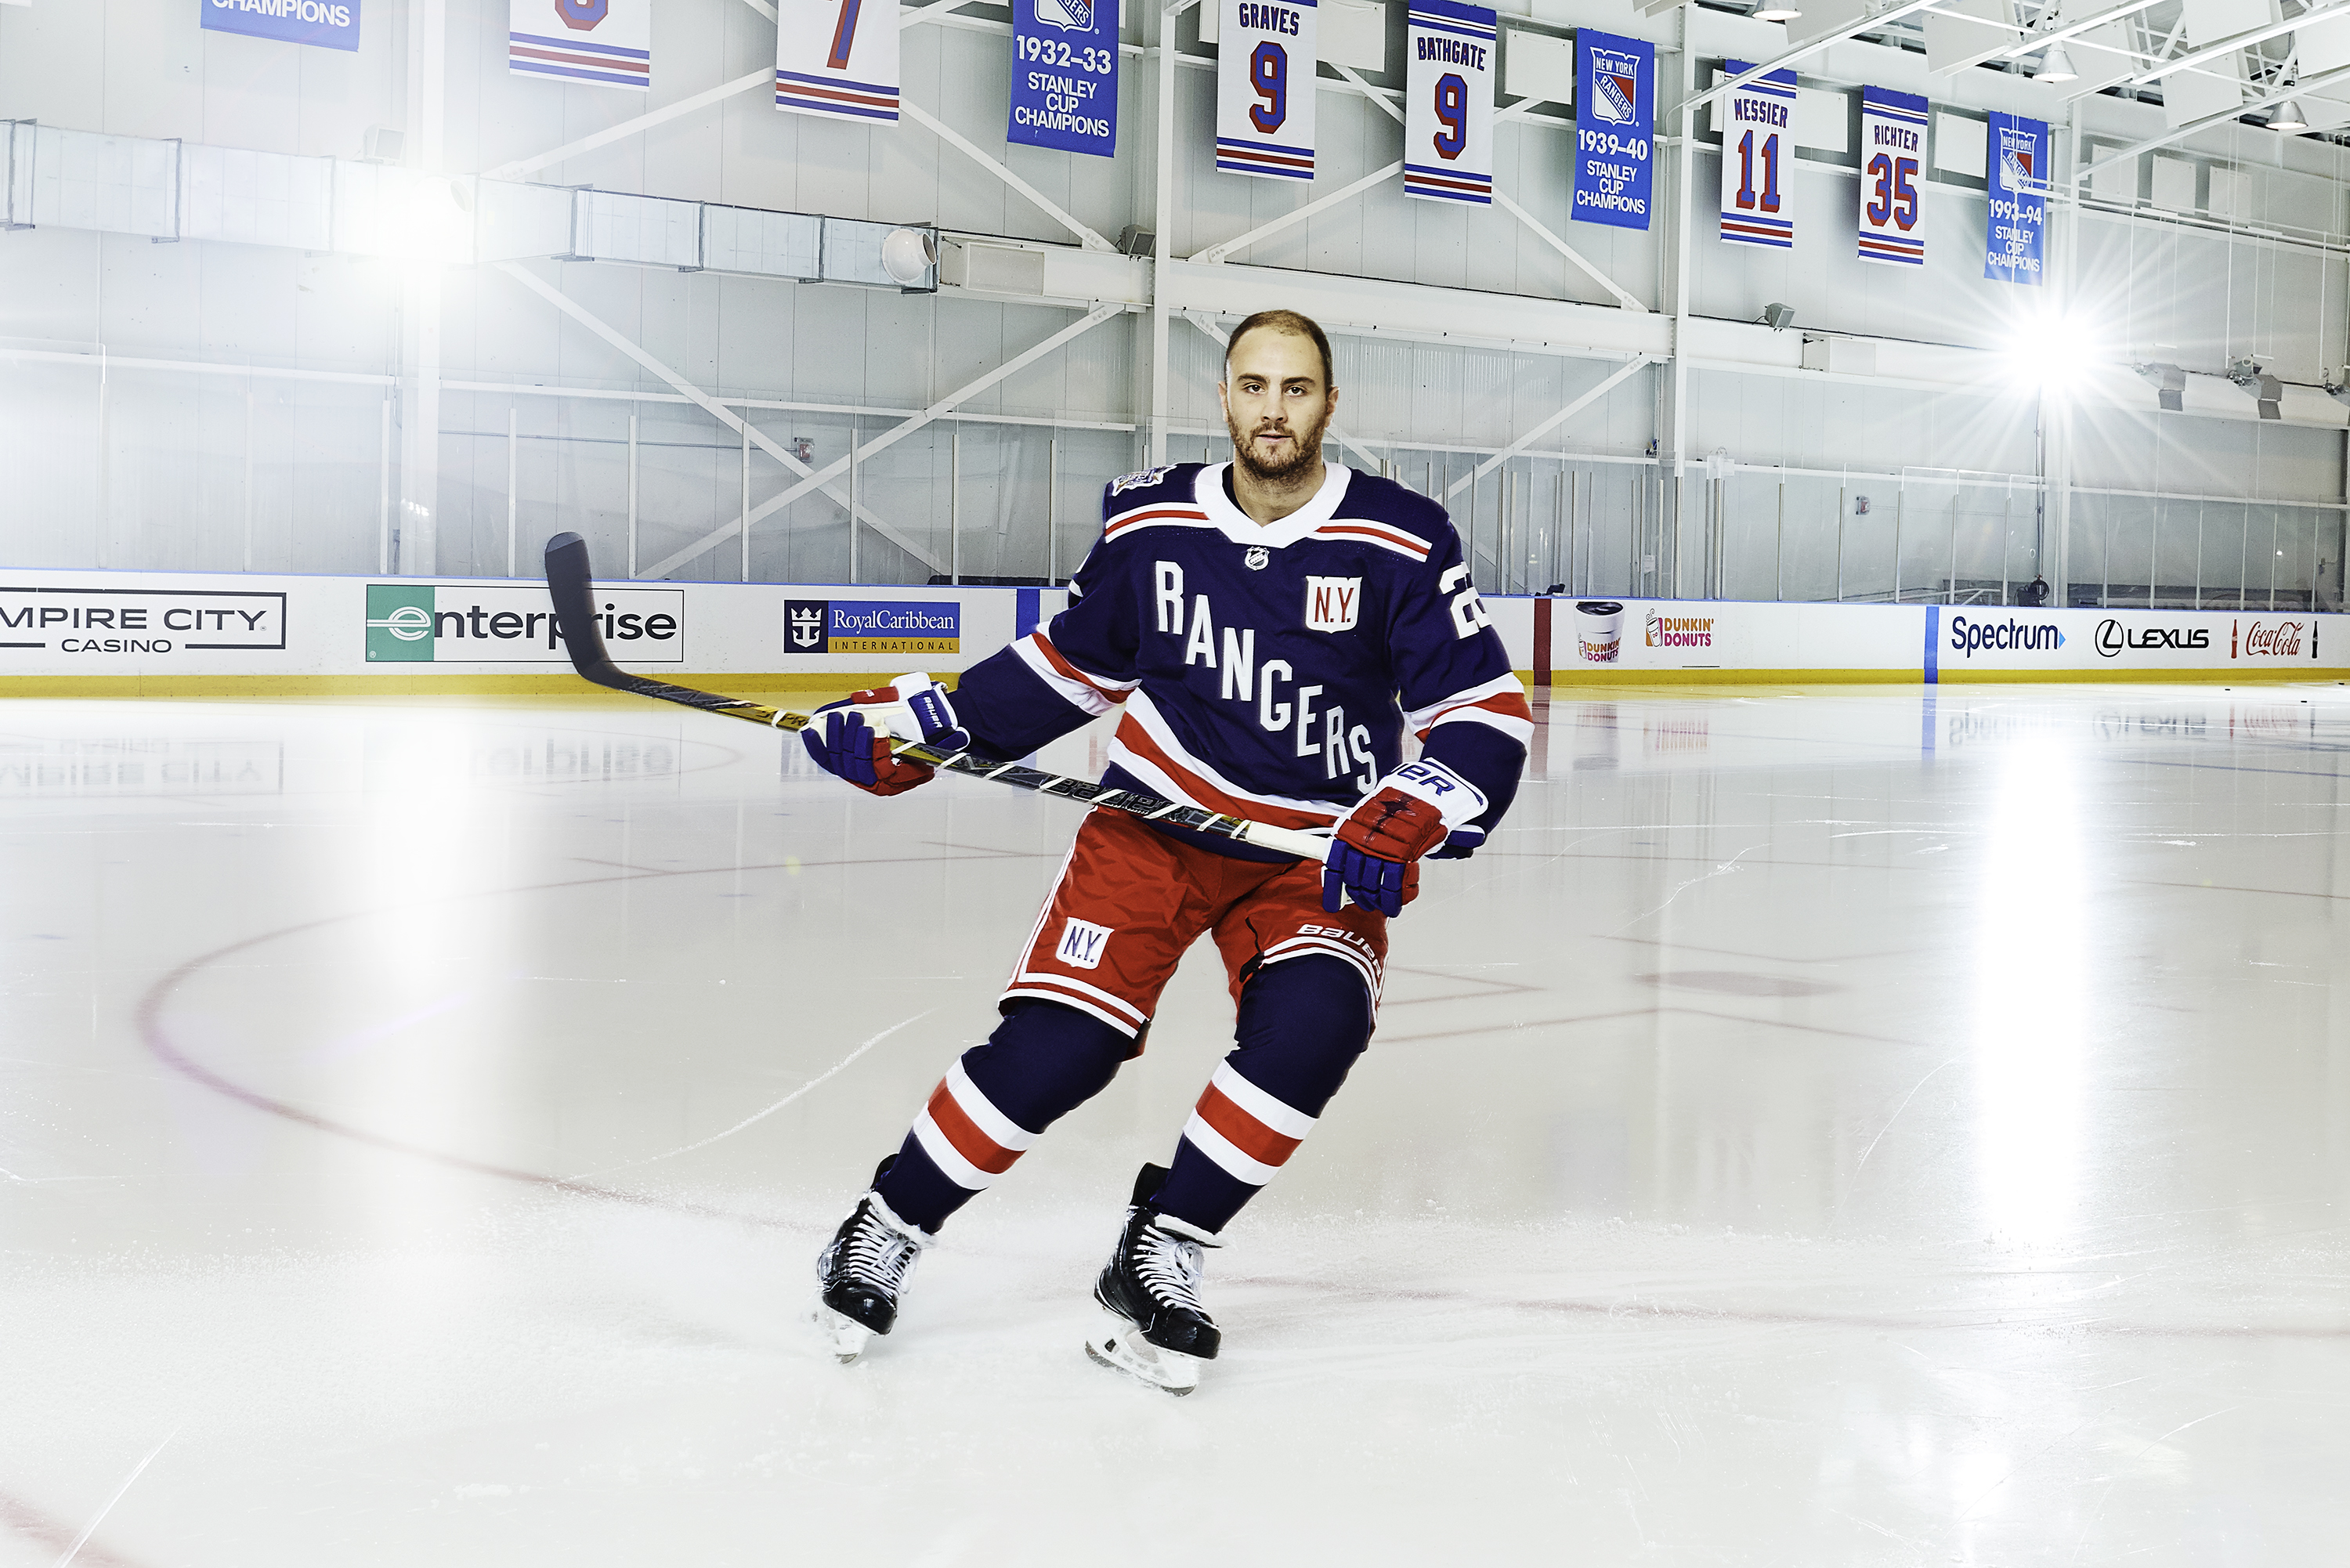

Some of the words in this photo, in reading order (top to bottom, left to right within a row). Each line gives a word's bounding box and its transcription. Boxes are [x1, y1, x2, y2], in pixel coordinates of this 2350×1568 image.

[1238, 2, 1300, 36] GRAVES
[1016, 34, 1112, 74] 1932-33
[1417, 36, 1487, 71] BATHGATE
[1596, 56, 1613, 72] NEW
[1615, 60, 1634, 76] YORK
[1028, 71, 1097, 99] STANLEY
[1249, 40, 1288, 135] 9
[1600, 75, 1632, 119] RANGERS
[1046, 93, 1079, 114] CUP
[1433, 72, 1468, 161] 9
[1734, 98, 1788, 128] MESSIER
[1015, 106, 1110, 137] CHAMPIONS
[1578, 129, 1648, 161] 1939-40
[1874, 125, 1918, 152] RICHTER
[1586, 160, 1637, 182] STANLEY
[1736, 129, 1781, 213] 11
[1599, 178, 1624, 195] CUP
[1867, 152, 1918, 231] 35
[1576, 190, 1646, 215] CHAMPIONS
[1989, 199, 2042, 226] 1993-94
[1995, 226, 2034, 244] STANLEY
[2005, 240, 2024, 255] CUP
[1987, 251, 2040, 272] CHAMPIONS
[1314, 586, 1354, 623] N.Y.
[163, 609, 267, 631] CITY
[833, 609, 955, 634] RoyalCaribbean
[1665, 618, 1714, 631] DUNKIN'
[61, 638, 172, 653] CASINO
[834, 641, 953, 650] INTERNATIONAL
[1665, 633, 1712, 647] DONUTS
[1951, 616, 2059, 658] Spectrum
[2128, 628, 2209, 649] LEXUS
[1587, 648, 1619, 662] DONUTS
[1155, 560, 1377, 795] RANGERS
[1063, 925, 1102, 963] N.Y.
